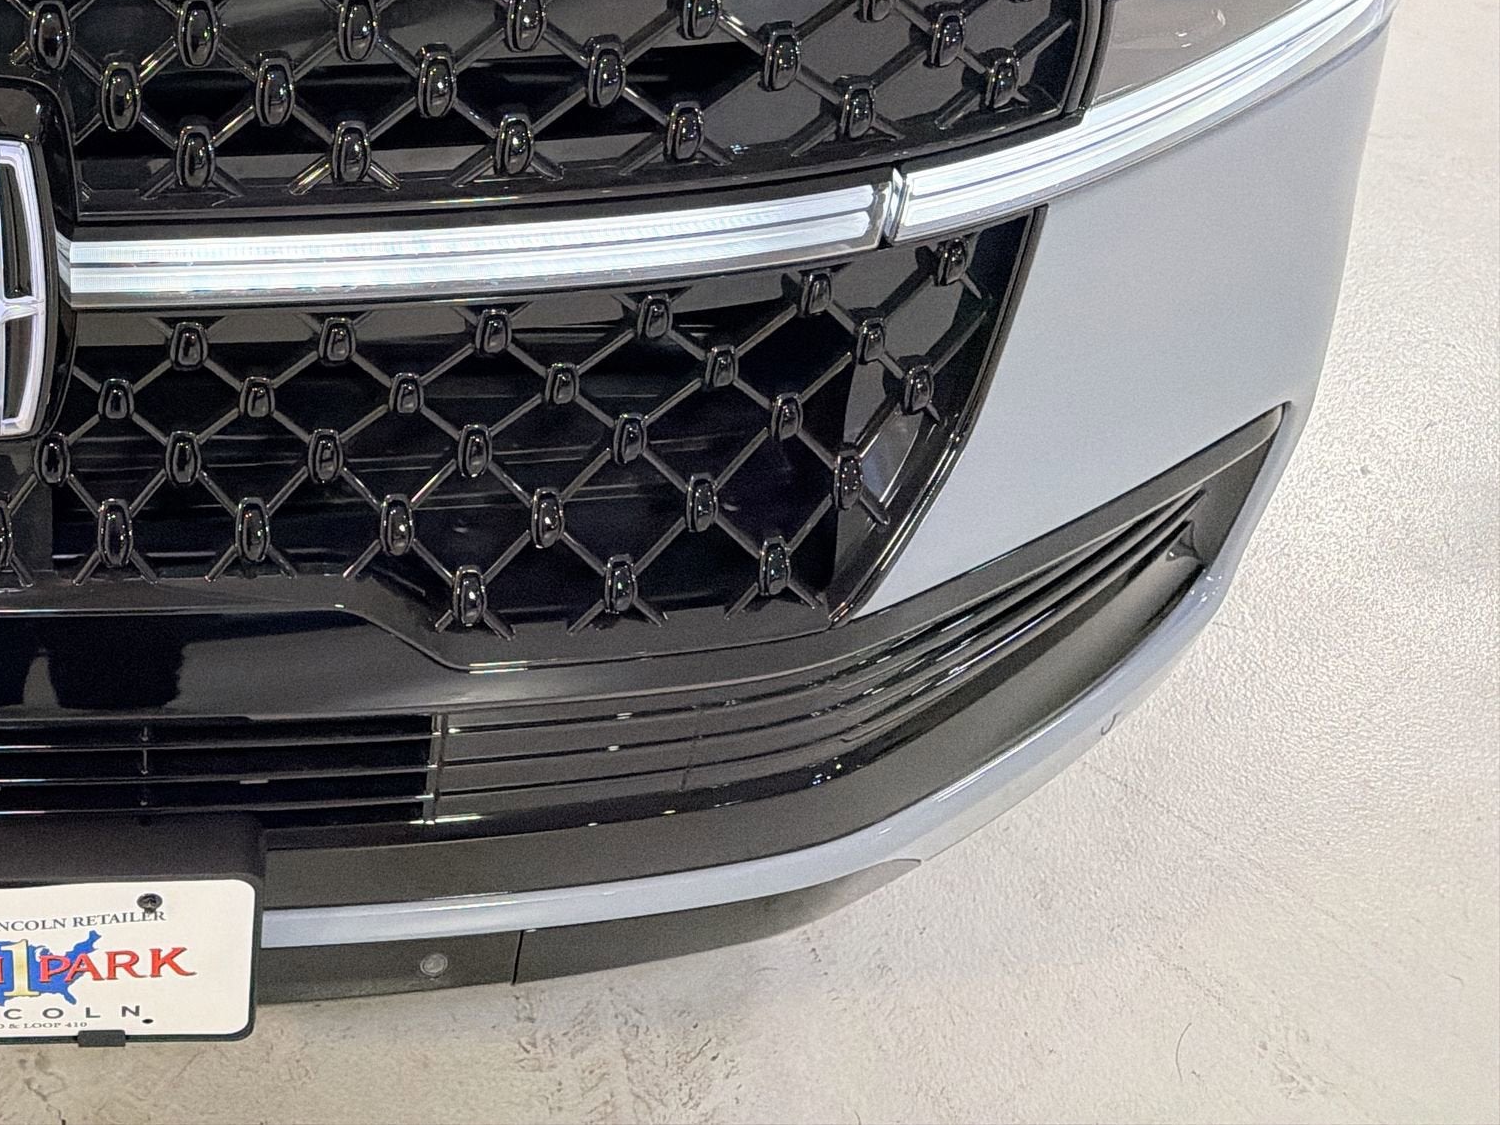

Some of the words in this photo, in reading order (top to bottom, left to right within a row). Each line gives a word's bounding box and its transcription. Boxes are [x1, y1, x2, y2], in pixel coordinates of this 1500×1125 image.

[72, 910, 167, 928] RETAILER
[39, 946, 198, 984] PARK
[23, 1022, 62, 1030] LOOP
